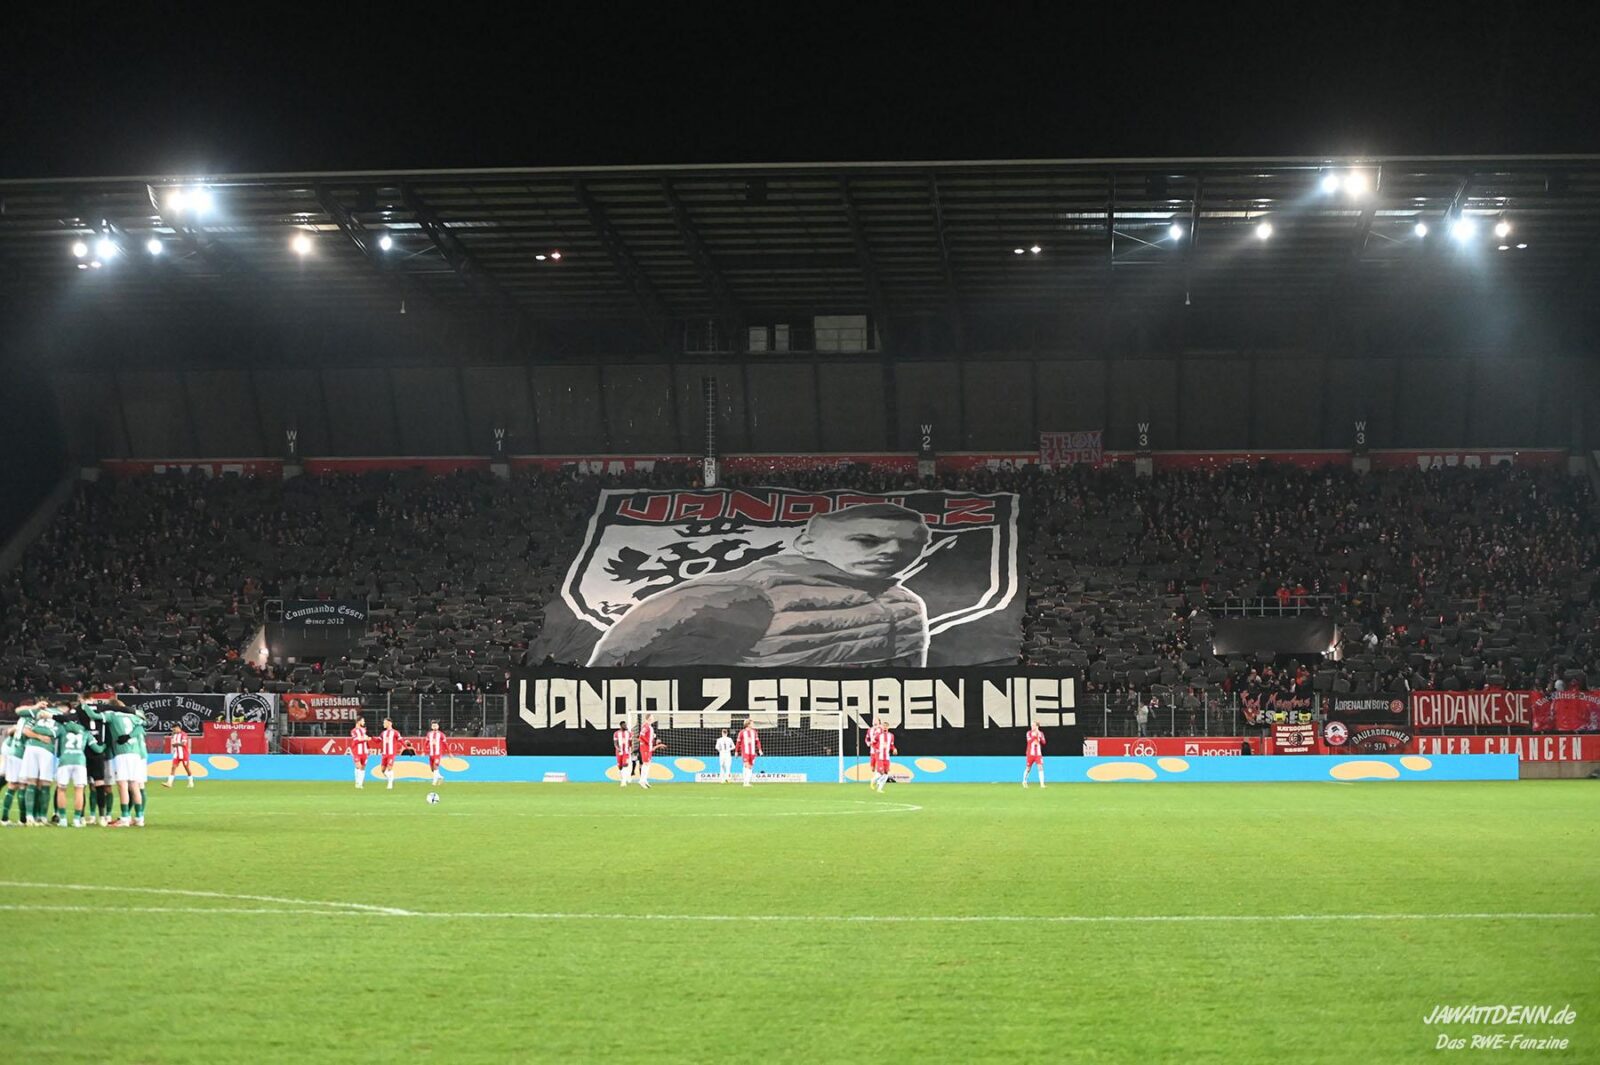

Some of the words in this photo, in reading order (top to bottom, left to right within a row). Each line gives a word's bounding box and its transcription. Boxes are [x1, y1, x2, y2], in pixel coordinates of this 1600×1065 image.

[921, 424, 932, 434] W
[1138, 423, 1149, 433] W
[1355, 421, 1366, 431] W
[287, 430, 297, 440] W
[494, 428, 504, 438] W
[1357, 432, 1365, 445] 3
[496, 440, 502, 451] 1
[922, 436, 931, 448] 2
[1140, 434, 1148, 446] 3
[289, 442, 294, 452] 1
[1040, 449, 1100, 464] KASTEN
[616, 490, 998, 524] VANDZ
[284, 604, 335, 620] Commando
[337, 605, 366, 620] Essen
[174, 695, 214, 717] Löwen
[748, 678, 965, 730] STERBEN
[983, 677, 1077, 729] NIE!
[1334, 699, 1372, 711] ADRENALIN
[1372, 700, 1390, 711] BOYS
[1504, 692, 1530, 724] SIE
[315, 708, 359, 720] ESSEN
[65, 731, 84, 749] 21
